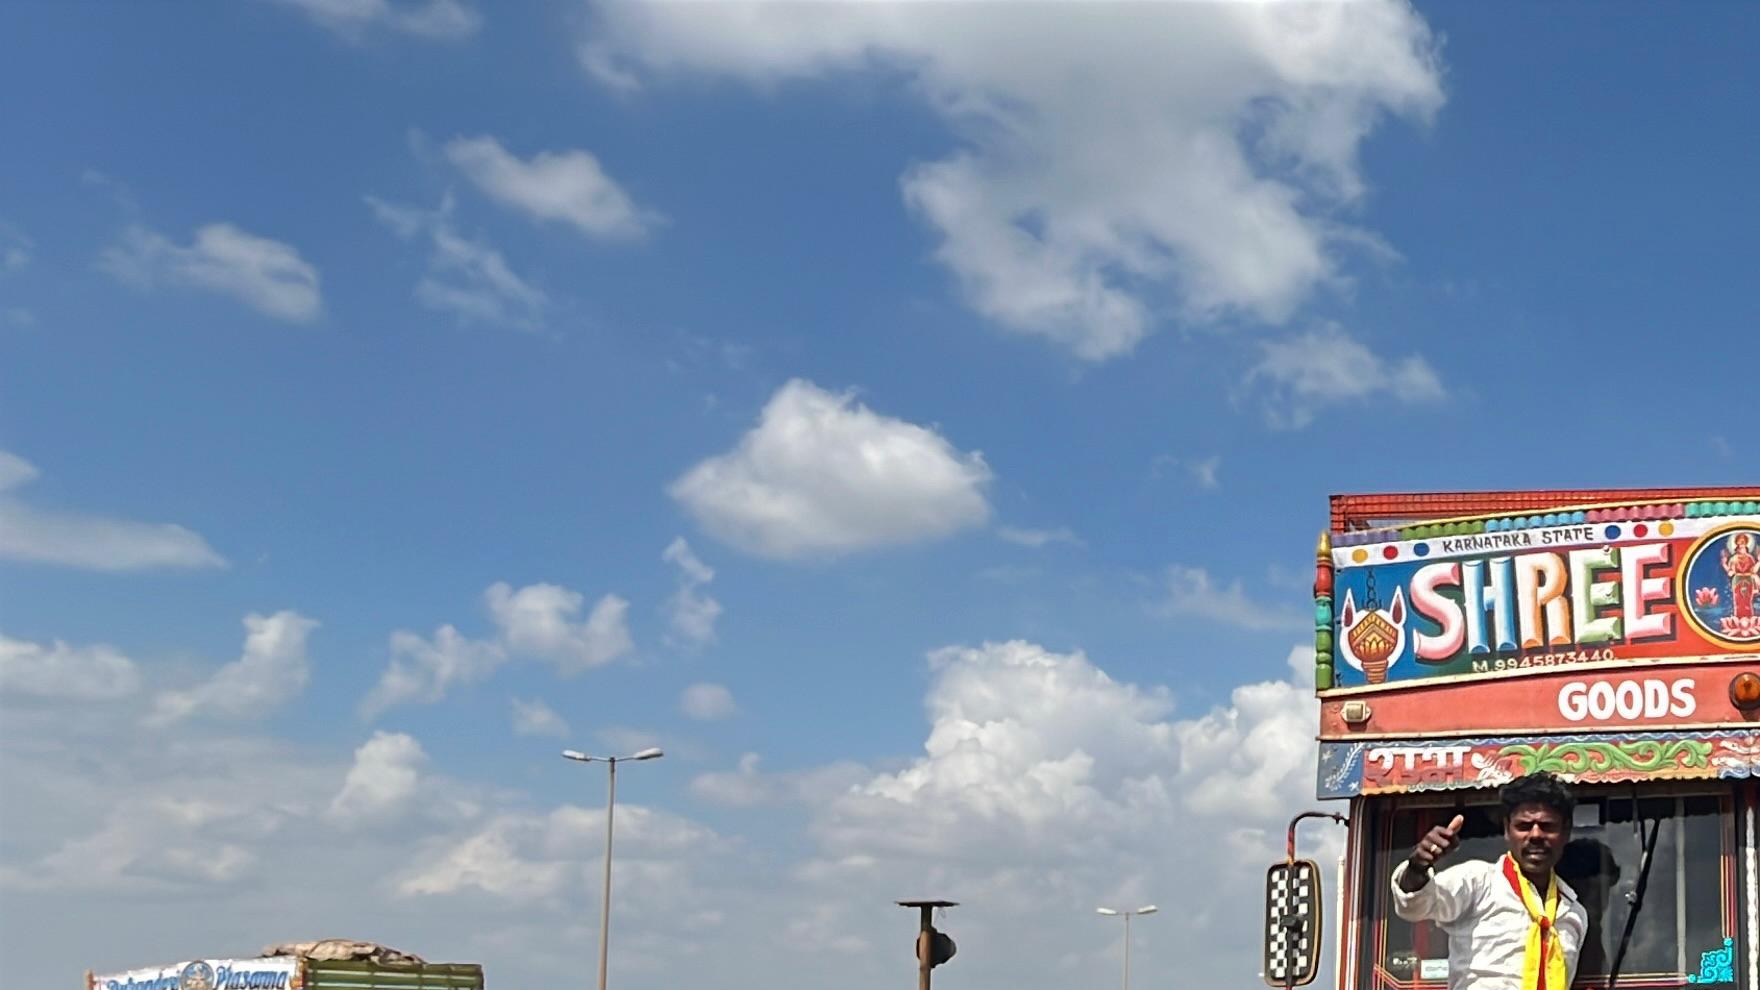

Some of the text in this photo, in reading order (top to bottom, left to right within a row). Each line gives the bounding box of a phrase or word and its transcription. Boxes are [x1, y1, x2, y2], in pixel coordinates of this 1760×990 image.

[1443, 526, 1594, 553] KARNATAKA STATE
[1410, 543, 1675, 661] SHREE
[1558, 678, 1697, 721] GOODS
